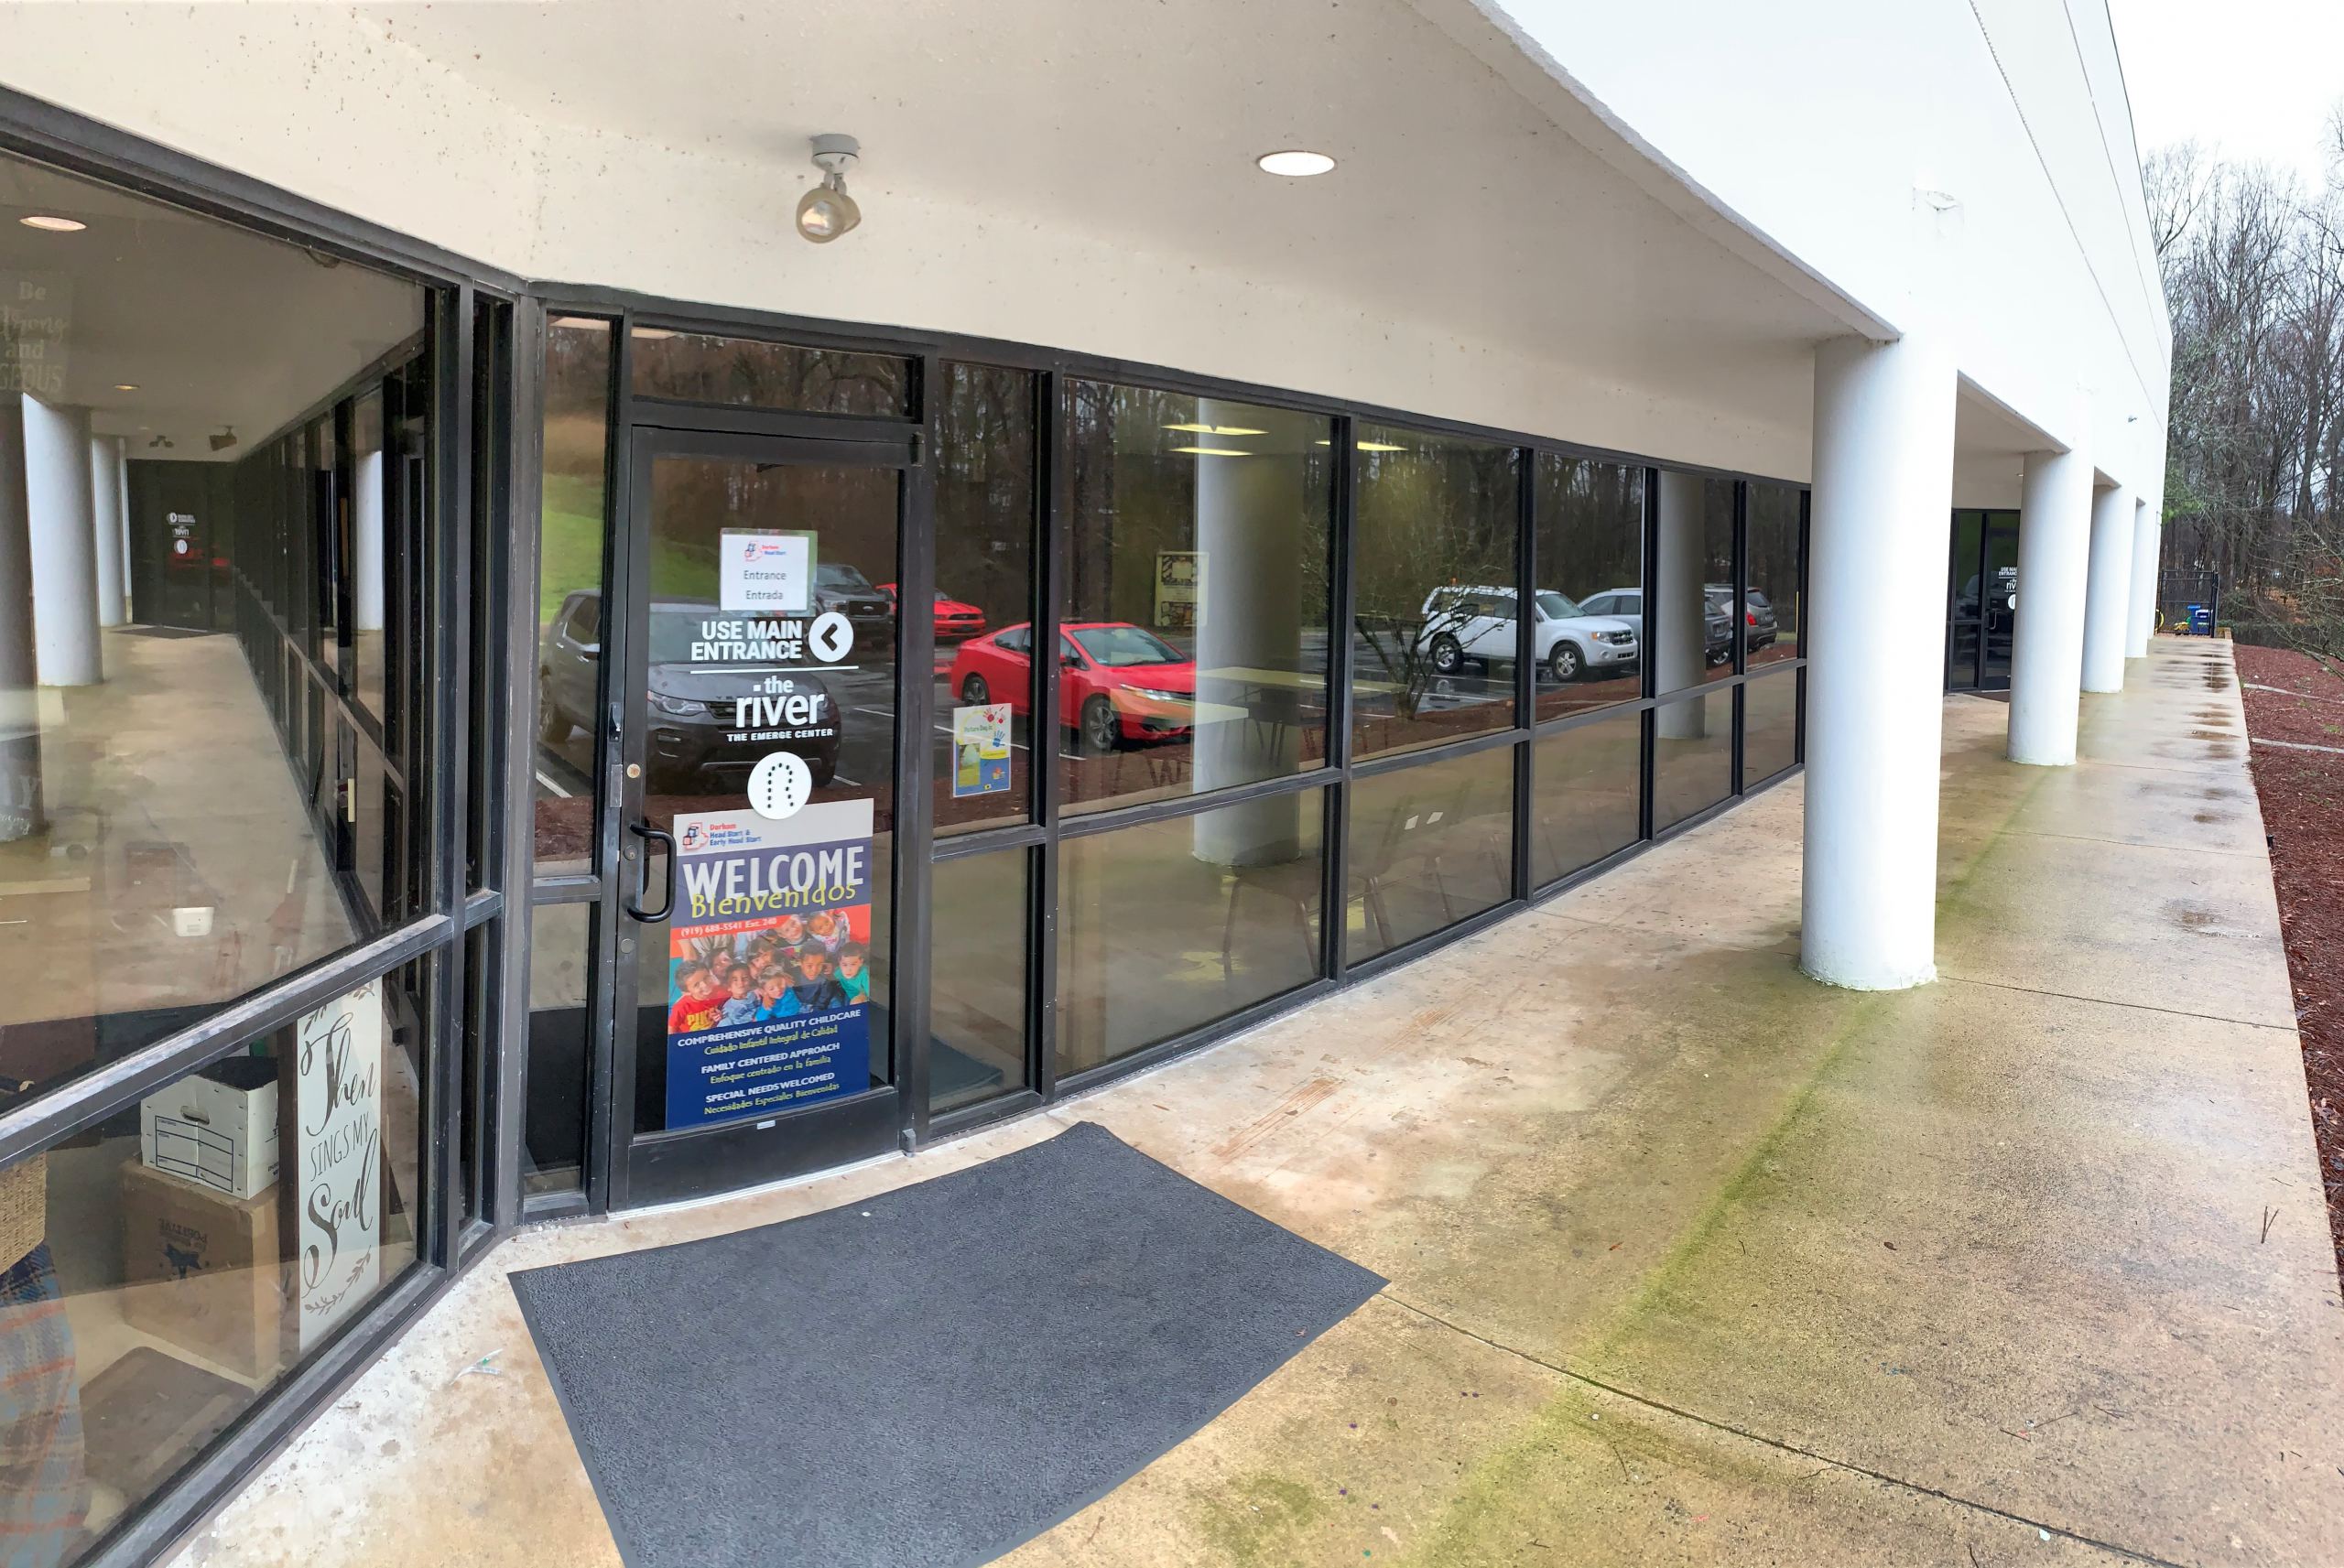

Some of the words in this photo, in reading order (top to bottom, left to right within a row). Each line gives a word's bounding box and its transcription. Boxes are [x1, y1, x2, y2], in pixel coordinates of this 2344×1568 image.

[743, 570, 787, 580] Entrance
[745, 589, 784, 600] Entrada
[701, 621, 743, 641] USE
[747, 620, 803, 640] MAIN
[690, 640, 803, 661] ENTRANCE
[764, 676, 794, 694] the
[735, 693, 826, 729] river
[727, 733, 748, 742] THE
[751, 730, 792, 741] EMERGE
[794, 728, 833, 739] CENTER
[682, 846, 864, 905] WELCOME
[691, 879, 857, 919] Bienvenidos
[680, 926, 703, 937] (919)
[678, 1024, 763, 1047] COMPREHENSIVE
[764, 1019, 807, 1034] QUALITY
[808, 1009, 862, 1025] CHILDCARE
[801, 1030, 810, 1040] de
[811, 1024, 838, 1038] Calidad
[701, 1061, 736, 1074] FAMILY
[737, 1052, 788, 1067] CENTERED
[789, 1042, 841, 1059] APPROACH
[783, 1063, 794, 1072] en
[300, 1012, 376, 1137] Then
[705, 1089, 745, 1104] SPECIAL
[747, 1083, 779, 1096] NEEDS
[778, 1072, 835, 1089] WELCOMED
[310, 1124, 350, 1183] SINGS
[352, 1110, 370, 1148] MY
[301, 1128, 378, 1299] Soul
